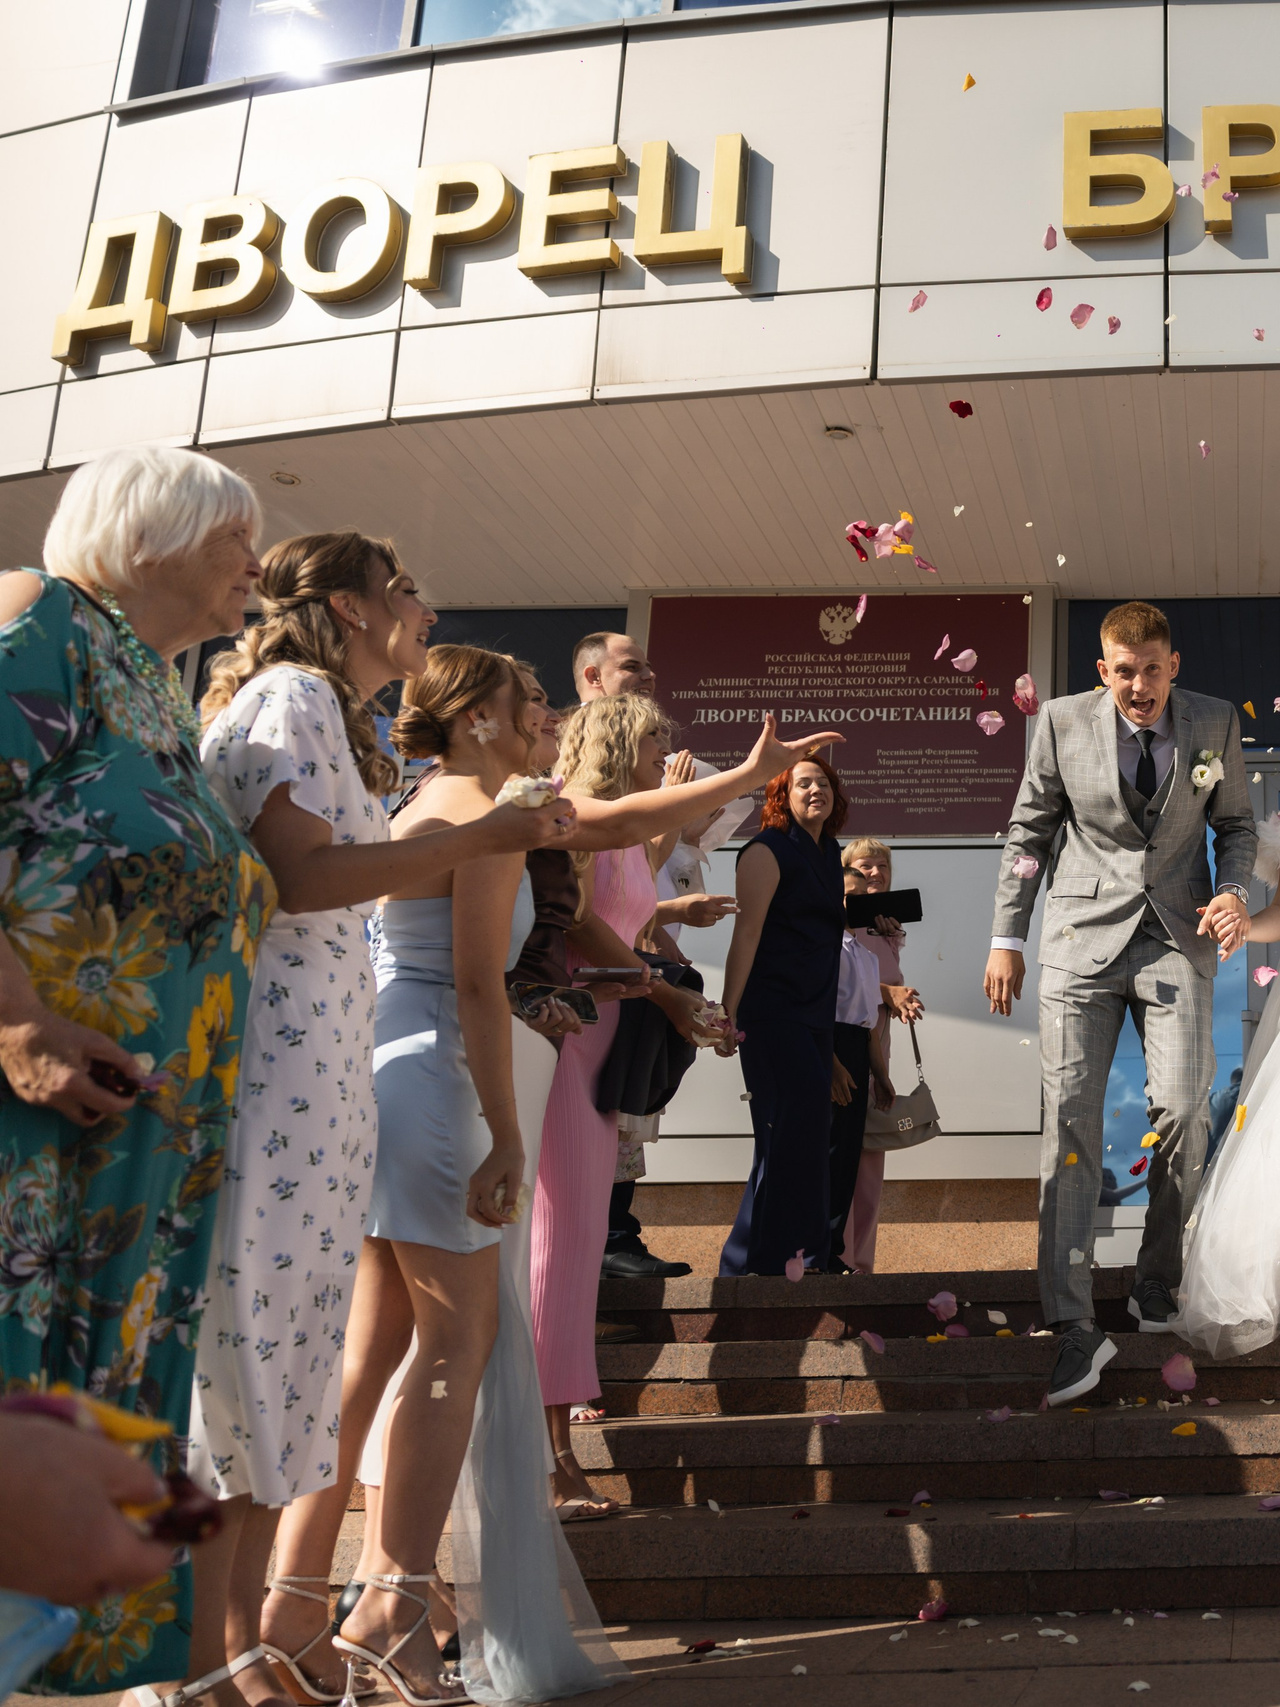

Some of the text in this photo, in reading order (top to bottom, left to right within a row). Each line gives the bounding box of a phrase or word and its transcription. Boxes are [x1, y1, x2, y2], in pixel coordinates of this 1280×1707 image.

[51, 132, 754, 367] ДВОРЕЦ
[765, 652, 911, 662] РОССИЙСКАЯ ФЕДЕРАЦИЯ
[767, 664, 907, 674] РЕСПУБЛИКА МОРДОВИЯ
[697, 675, 975, 687] АДМИНИСТРАЦИЯ ГОРОДСКОГО ОКРУГА САРАНСК
[671, 690, 746, 699] УПРАВЛЕНИЕ
[749, 689, 794, 698] ЗАПИСИ
[796, 689, 834, 698] АКТОВ
[836, 688, 927, 698] ГРАЖДАНСКОГО
[780, 707, 972, 723] БРАКОСОЧЕТАНИЯ
